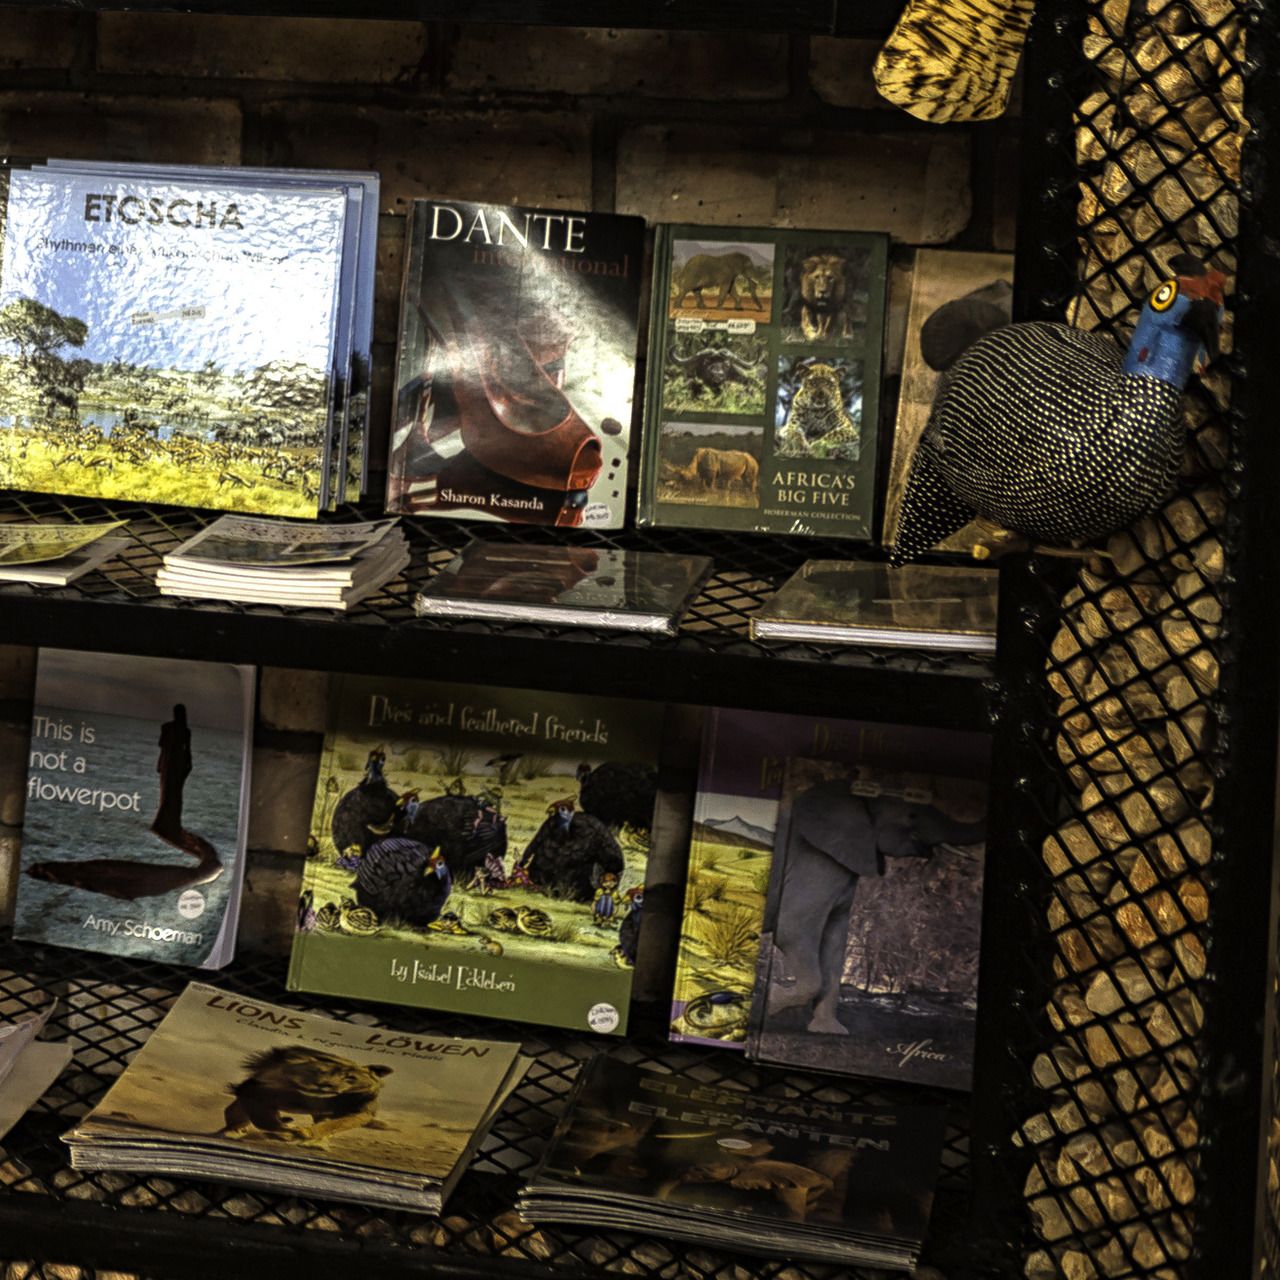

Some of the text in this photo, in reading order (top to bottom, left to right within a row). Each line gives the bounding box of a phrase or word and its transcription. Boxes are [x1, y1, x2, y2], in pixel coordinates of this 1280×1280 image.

[84, 194, 244, 230] ETOSCHA
[429, 206, 586, 253] DANTE
[772, 471, 856, 490] AFRICA'S
[440, 489, 544, 510] Sharon Kasanda
[778, 489, 850, 506] BIG FIVE
[810, 511, 861, 520] COLLECTION
[33, 716, 96, 743] This is
[368, 695, 609, 744] Elves and feathered friends
[30, 751, 86, 773] not a
[28, 776, 141, 812] flowerpot
[82, 914, 202, 945] Amy Schoeman
[391, 959, 407, 982] by
[412, 960, 452, 985] Isabel
[206, 995, 305, 1030] LIONS
[365, 1032, 491, 1059] LÖWEN
[885, 1038, 949, 1067] Africa
[629, 1101, 889, 1151] ELEFANTEN
